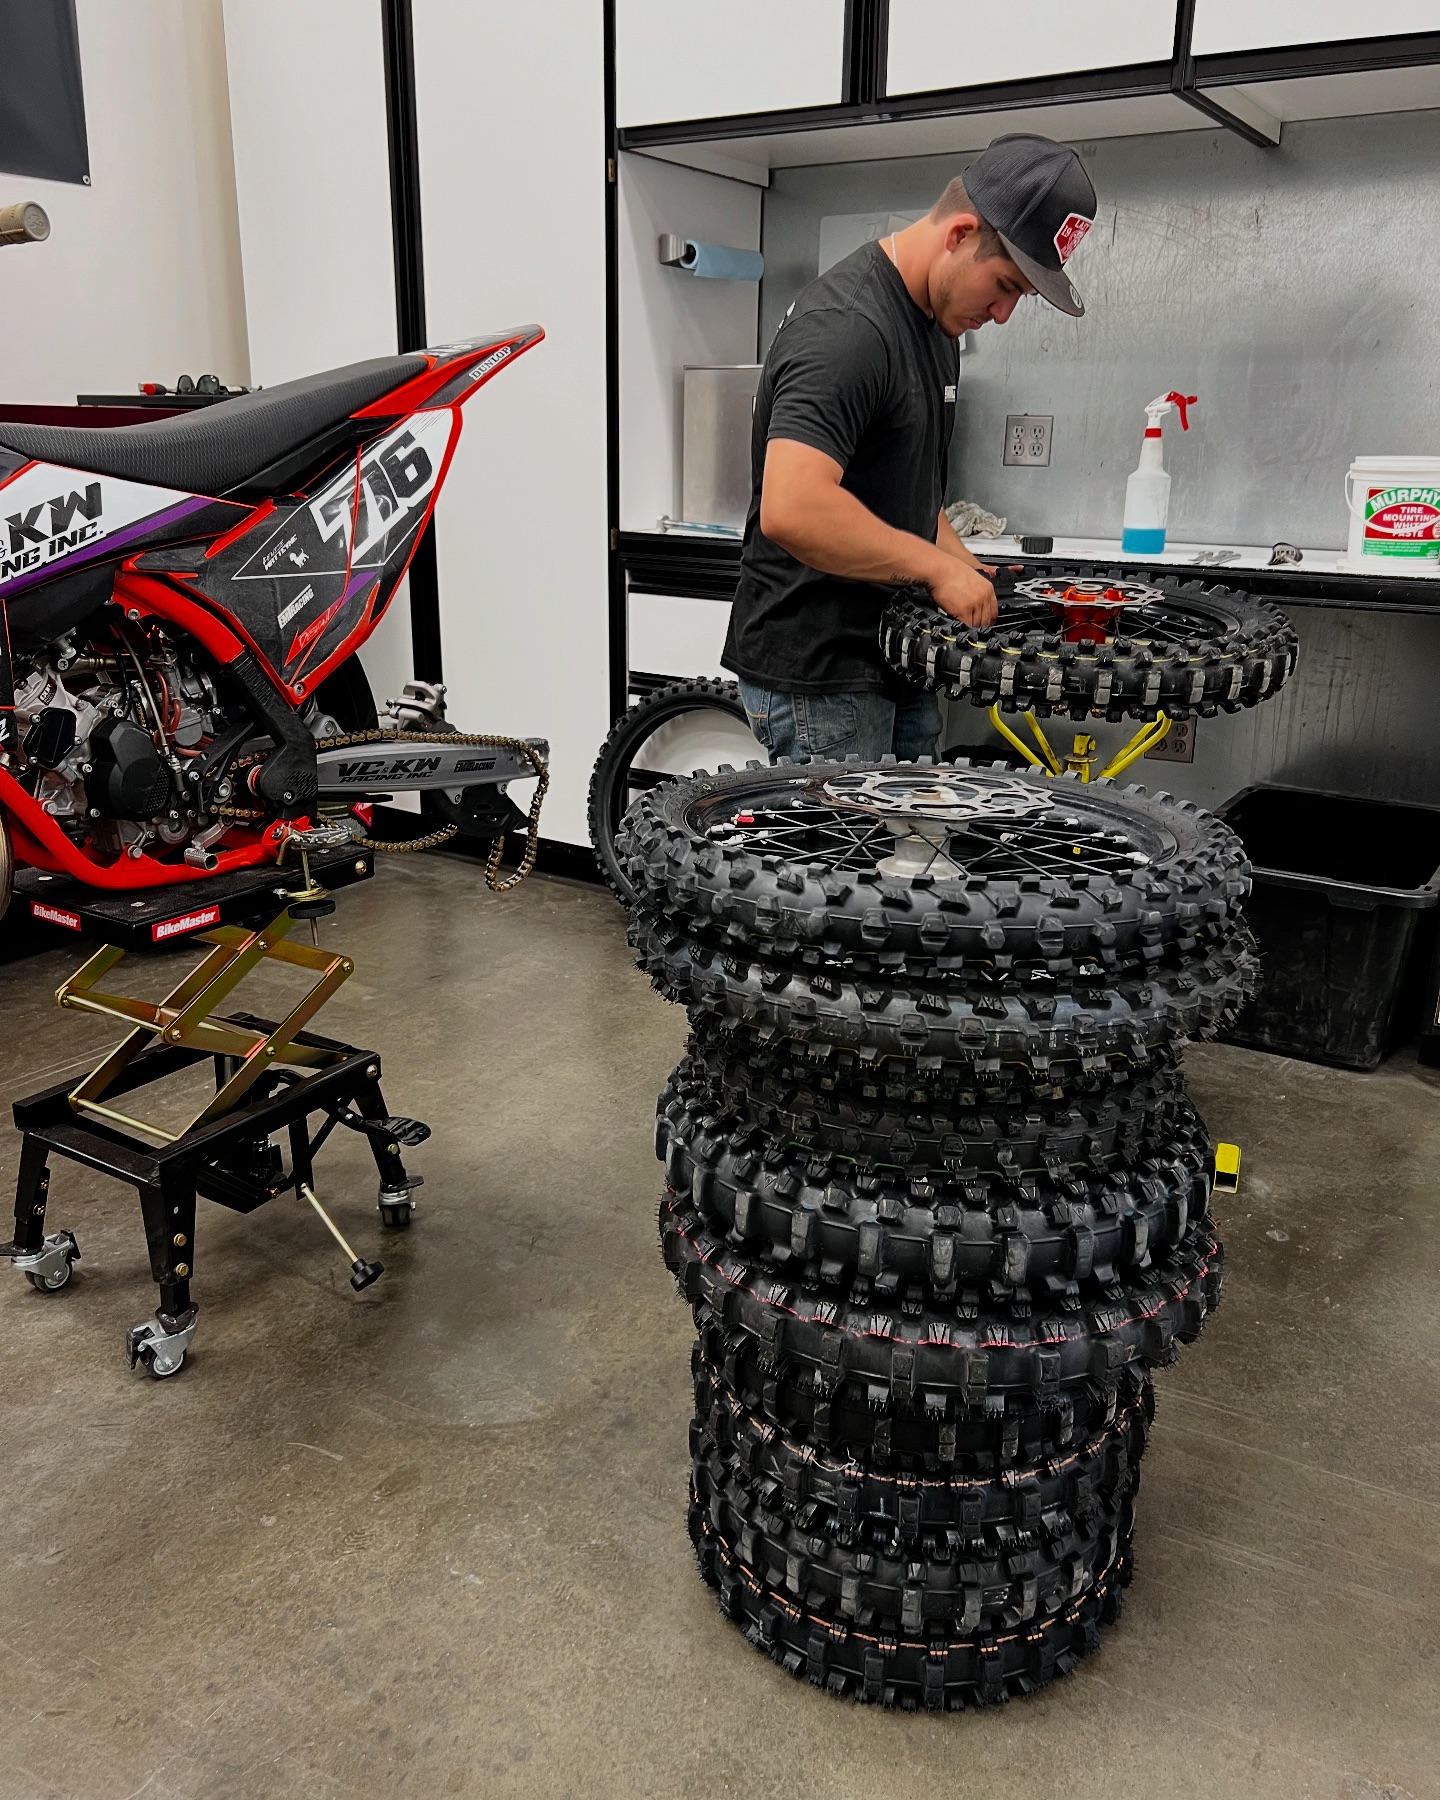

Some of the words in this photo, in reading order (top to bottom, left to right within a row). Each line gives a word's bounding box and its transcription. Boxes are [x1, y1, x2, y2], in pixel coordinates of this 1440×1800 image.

[470, 346, 511, 380] DUNLOP
[1369, 488, 1440, 513] MURPHY
[1400, 506, 1424, 514] TIRE
[1393, 521, 1425, 530] WHIT
[48, 521, 104, 557] INC.
[339, 773, 405, 784] RACING
[33, 904, 78, 928] BikeMaster
[156, 910, 217, 938] BikeMaster
